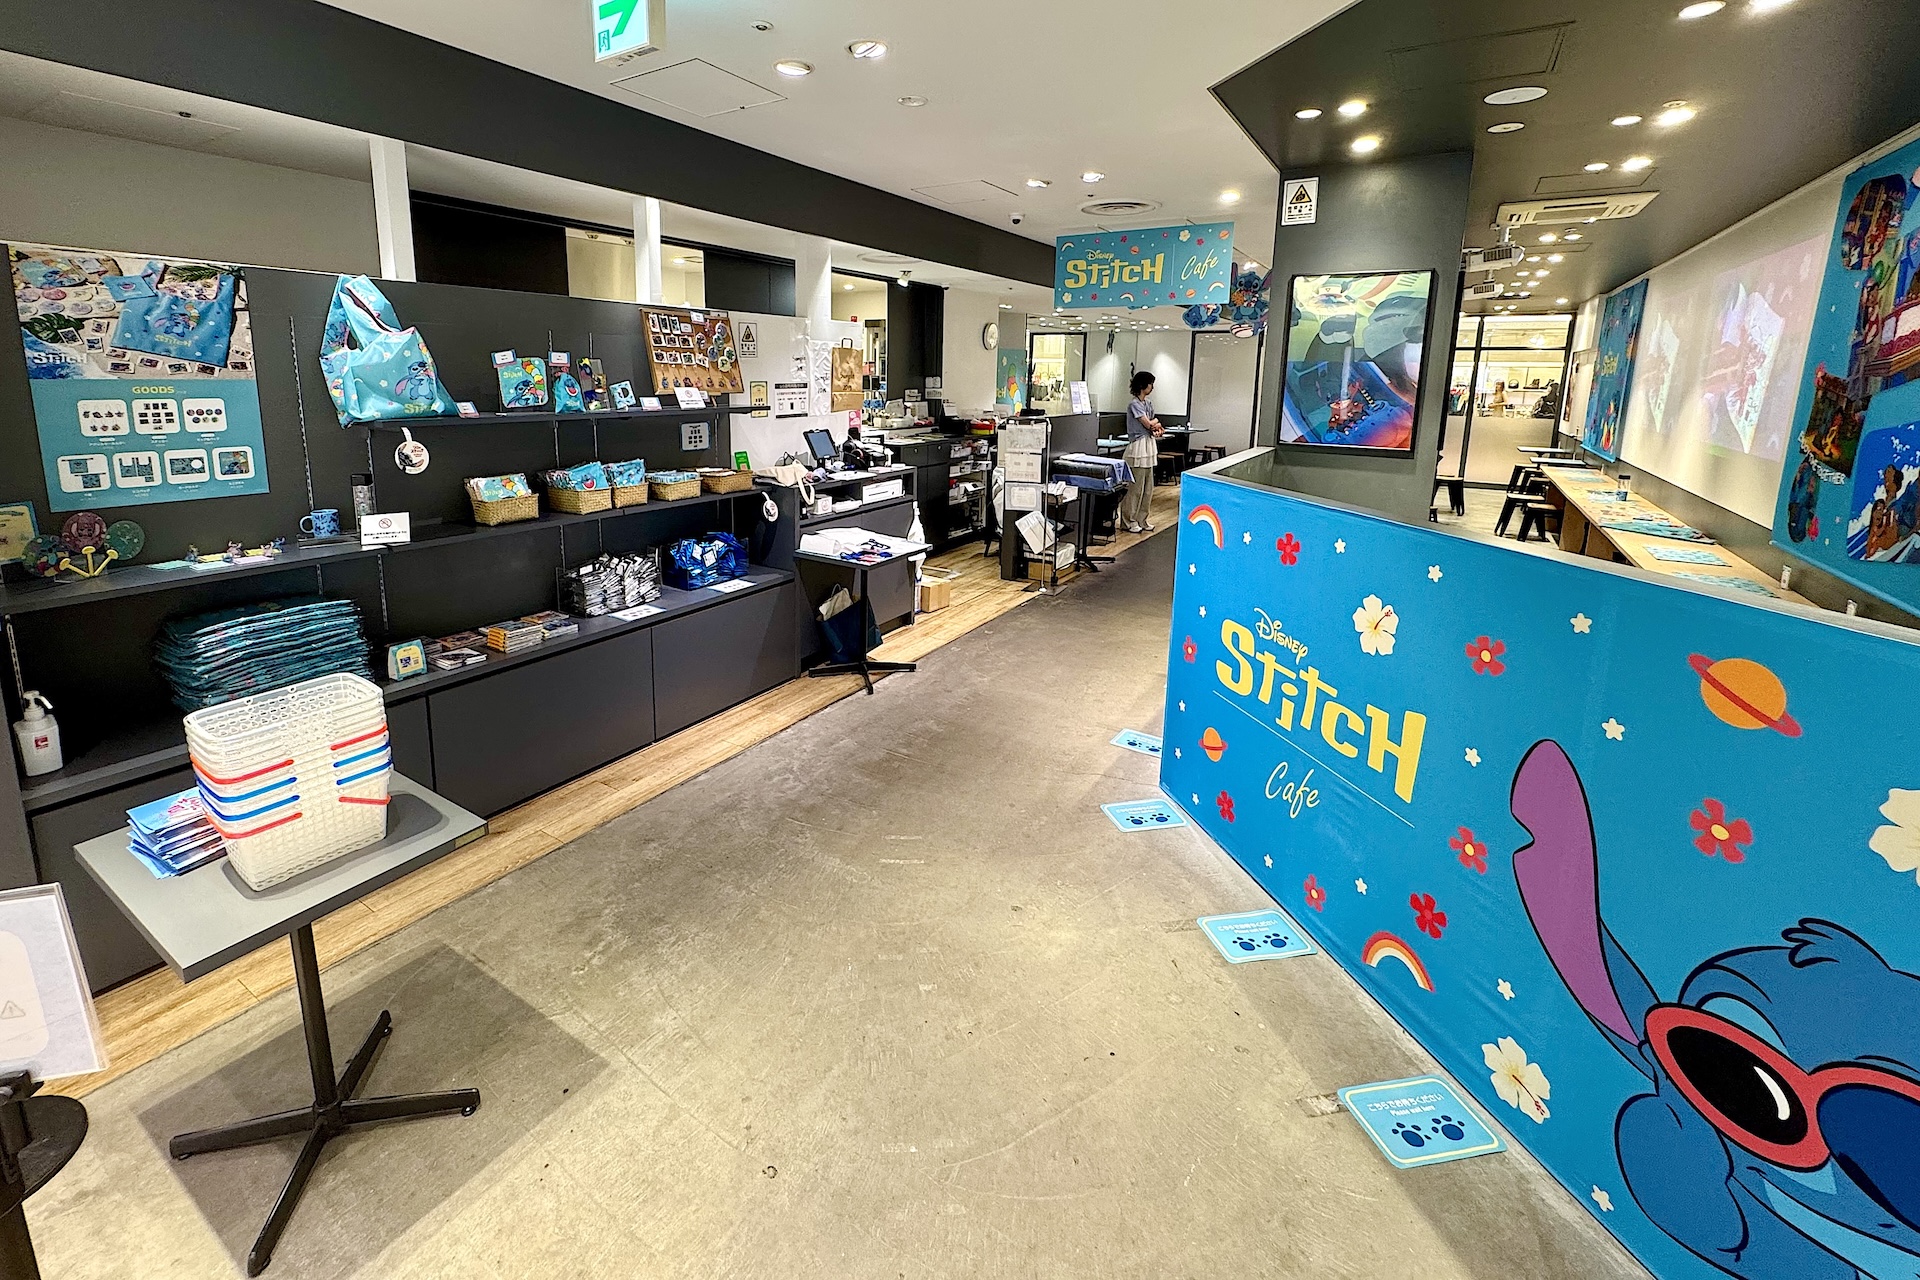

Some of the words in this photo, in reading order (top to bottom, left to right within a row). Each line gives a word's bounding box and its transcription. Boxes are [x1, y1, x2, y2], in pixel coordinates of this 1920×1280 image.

[1181, 249, 1219, 281] Cafe
[132, 386, 175, 394] GOODS
[1265, 761, 1320, 819] Cafe
[1367, 1092, 1445, 1112] こちらでお待ちください
[1390, 1108, 1411, 1117] Please
